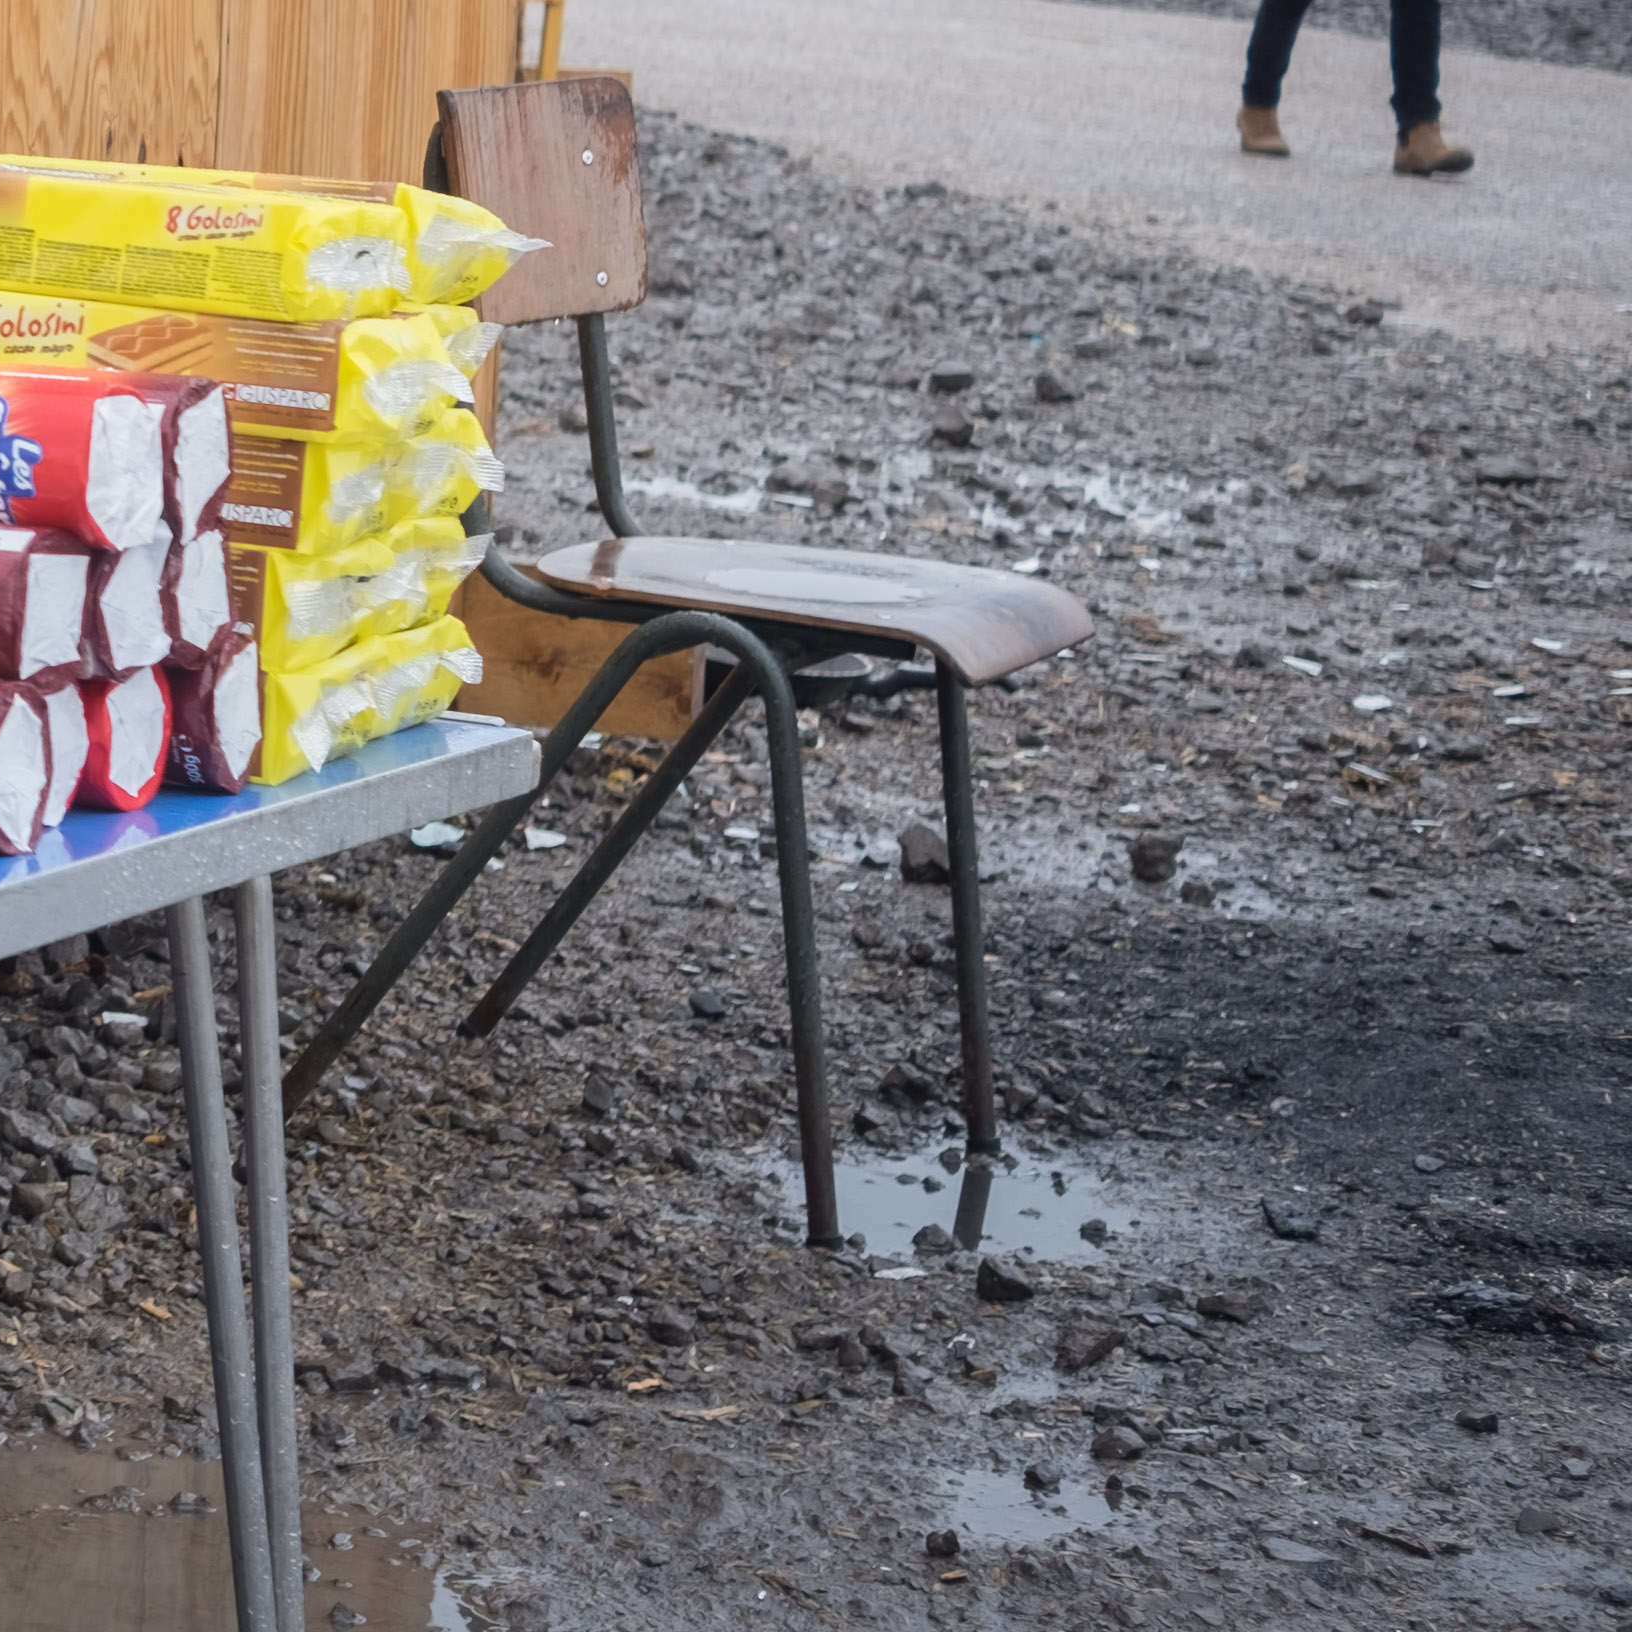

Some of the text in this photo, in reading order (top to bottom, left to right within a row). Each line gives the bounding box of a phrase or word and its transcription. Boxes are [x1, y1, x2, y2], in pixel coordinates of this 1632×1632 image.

[166, 203, 265, 235] 8 Golosini
[238, 385, 330, 410] GUSPARO
[11, 439, 42, 490] Les
